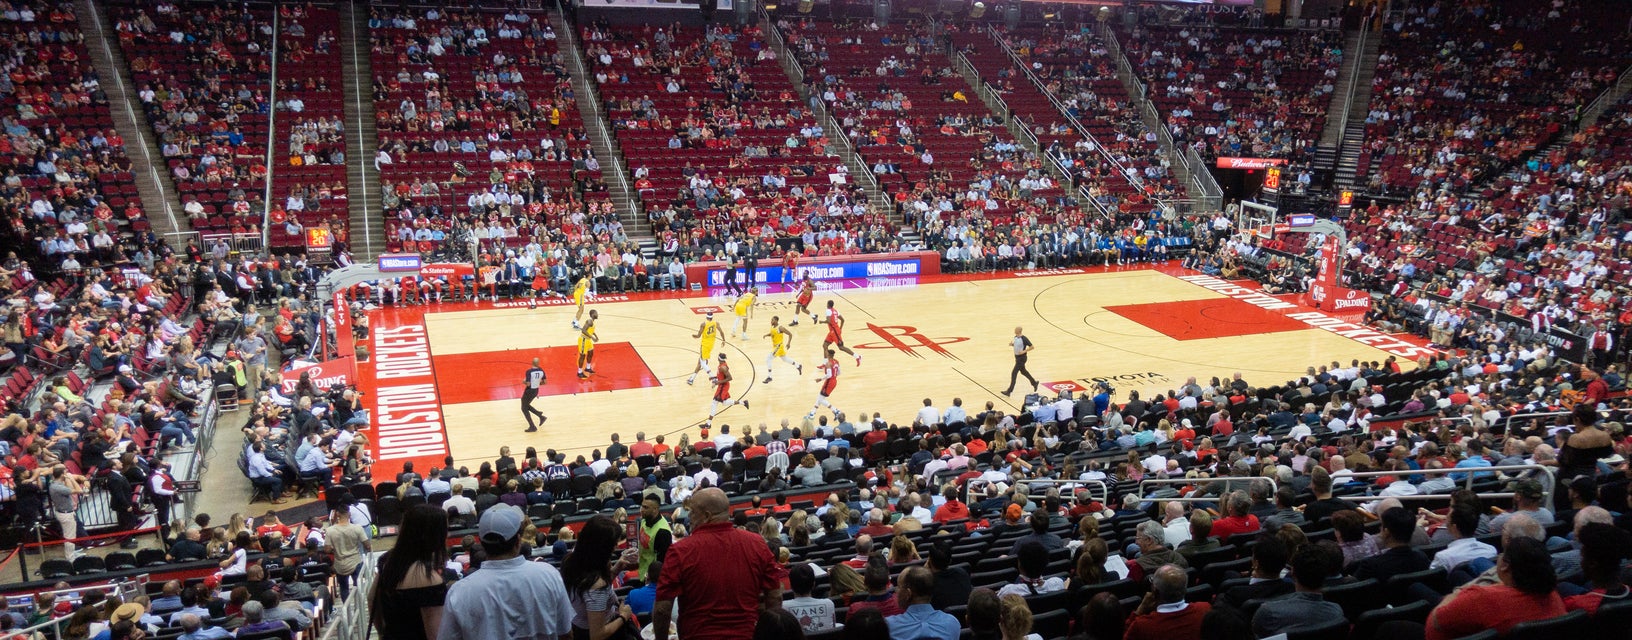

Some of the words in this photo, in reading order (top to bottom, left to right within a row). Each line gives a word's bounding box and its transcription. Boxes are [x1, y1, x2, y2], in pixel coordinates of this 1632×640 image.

[312, 236, 325, 245] 20
[873, 262, 917, 275] NBAStore.com
[1177, 274, 1298, 310] HOUSTON
[1335, 297, 1369, 310] SPALDING
[337, 313, 345, 326] TV
[1285, 311, 1435, 357] ROCKETS
[374, 324, 432, 380] ROCKETS
[283, 375, 347, 393] SPDING
[1079, 372, 1164, 384] TOYOTA
[376, 383, 446, 460] HOUSTON
[792, 606, 824, 616] VANS
